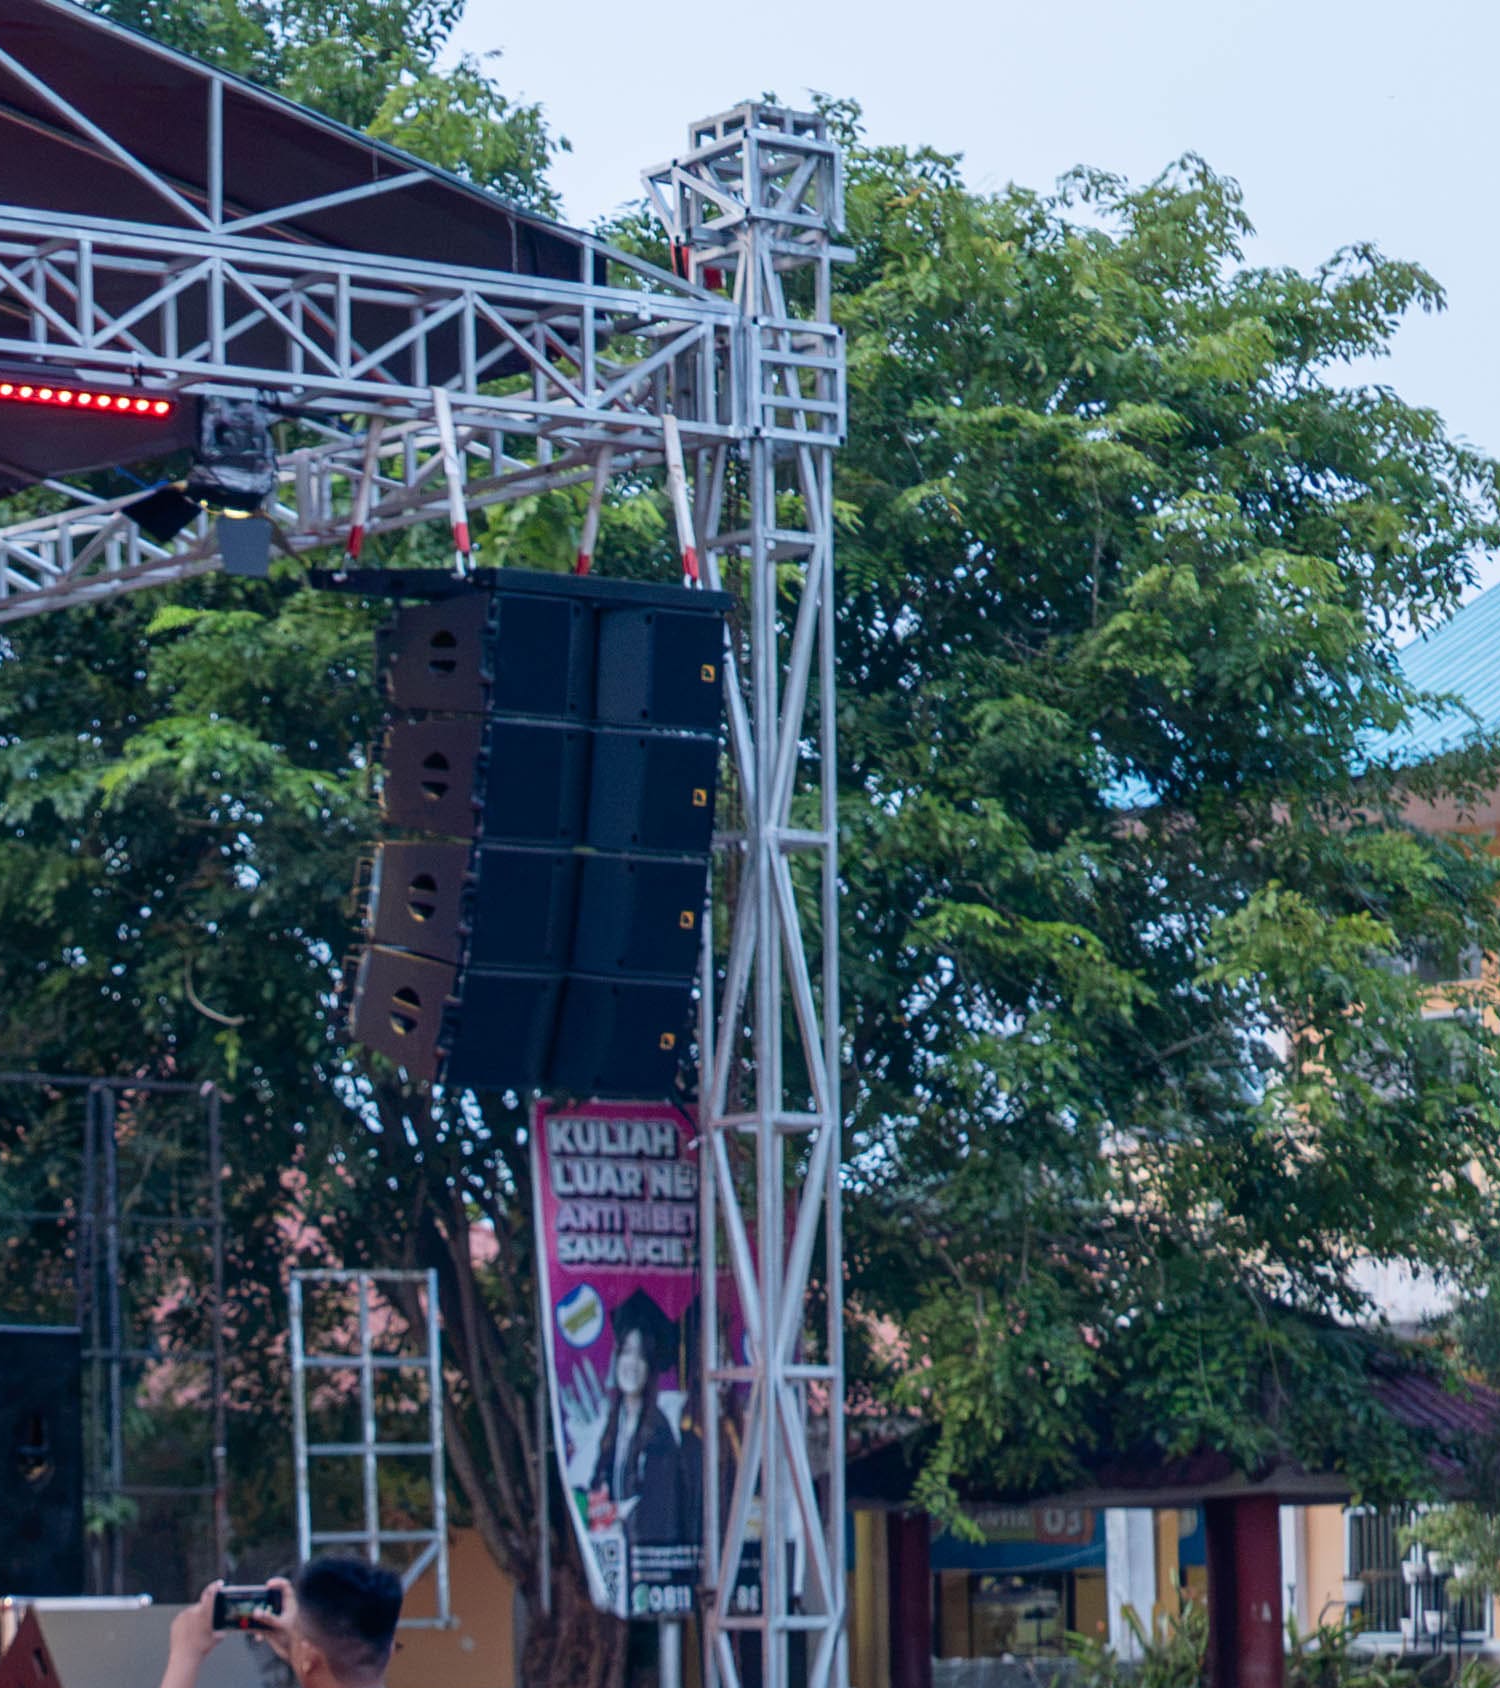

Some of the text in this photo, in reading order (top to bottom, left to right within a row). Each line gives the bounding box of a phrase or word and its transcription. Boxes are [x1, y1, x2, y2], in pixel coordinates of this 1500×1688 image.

[550, 1120, 677, 1156] KULIAH
[553, 1160, 644, 1196] LUAR
[556, 1202, 624, 1233] ANTI
